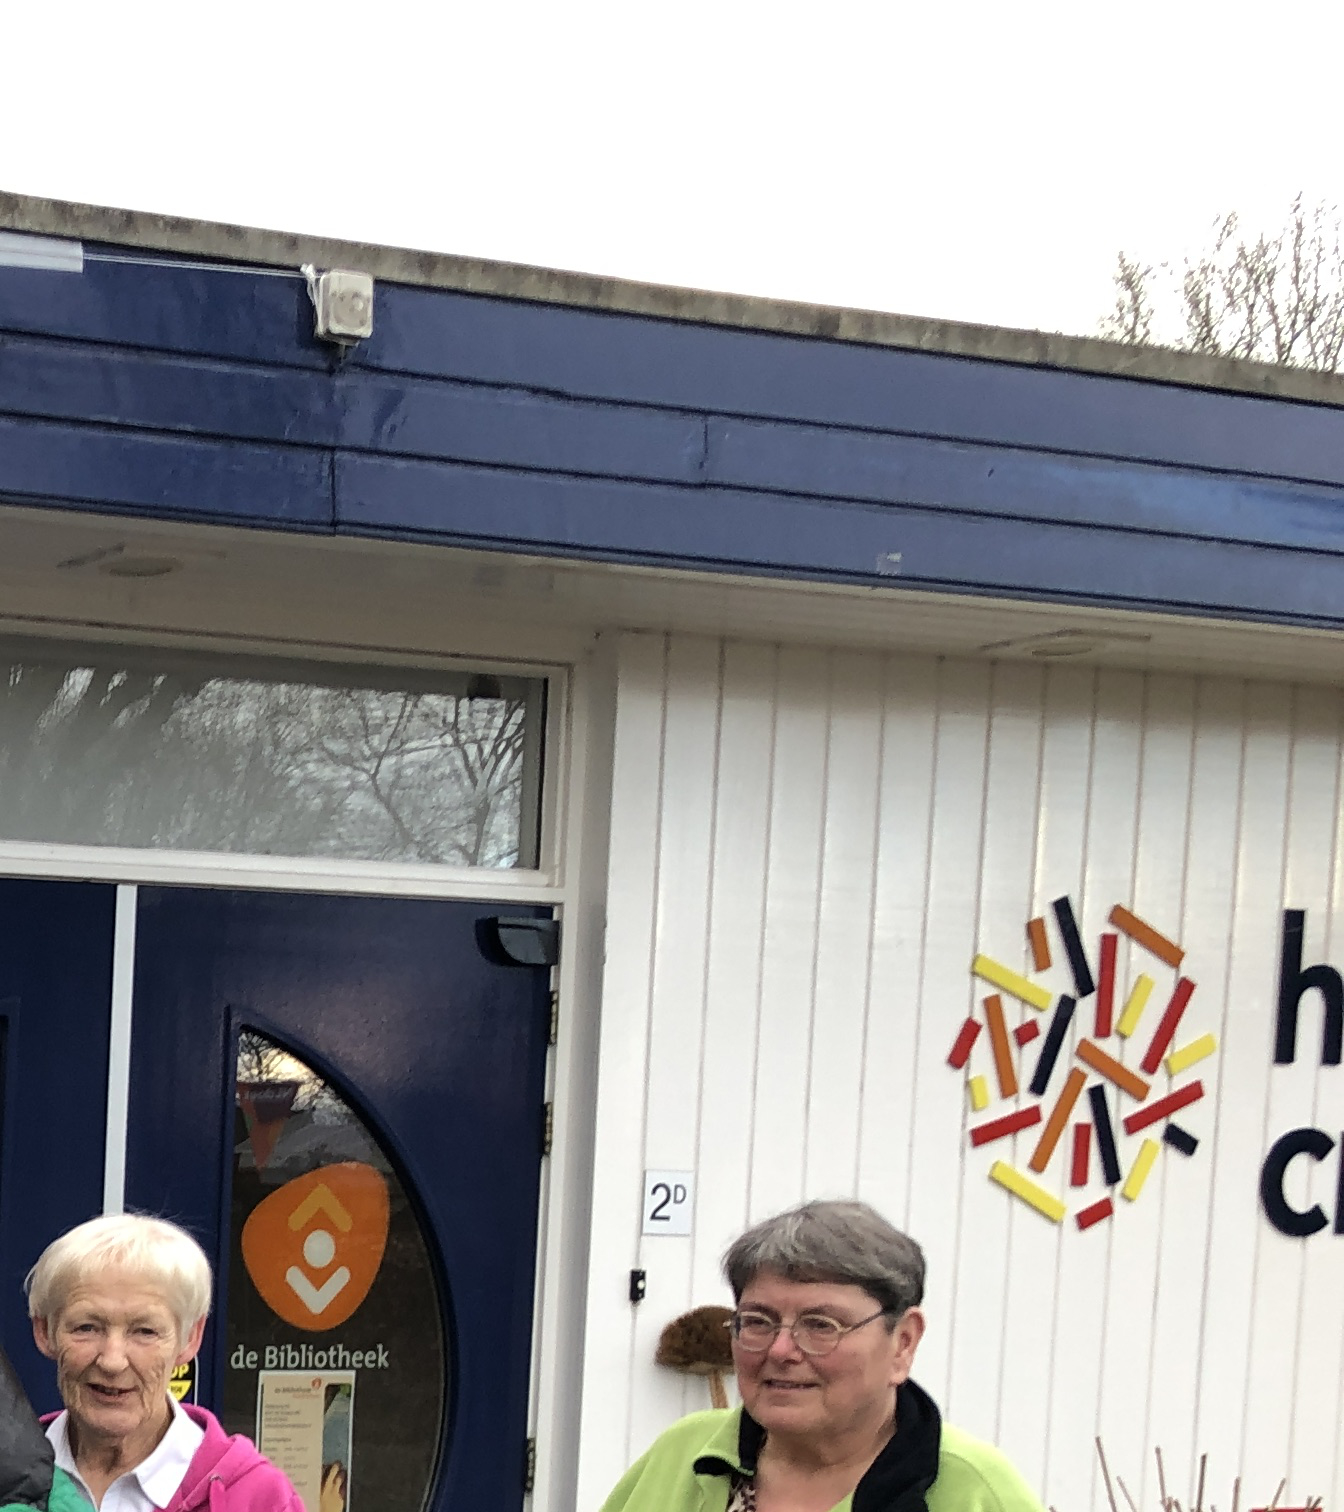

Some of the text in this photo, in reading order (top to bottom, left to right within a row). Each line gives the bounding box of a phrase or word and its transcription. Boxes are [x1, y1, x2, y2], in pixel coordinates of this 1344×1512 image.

[649, 1182, 688, 1222] 2D
[230, 1343, 390, 1370] de Bibliotheek
